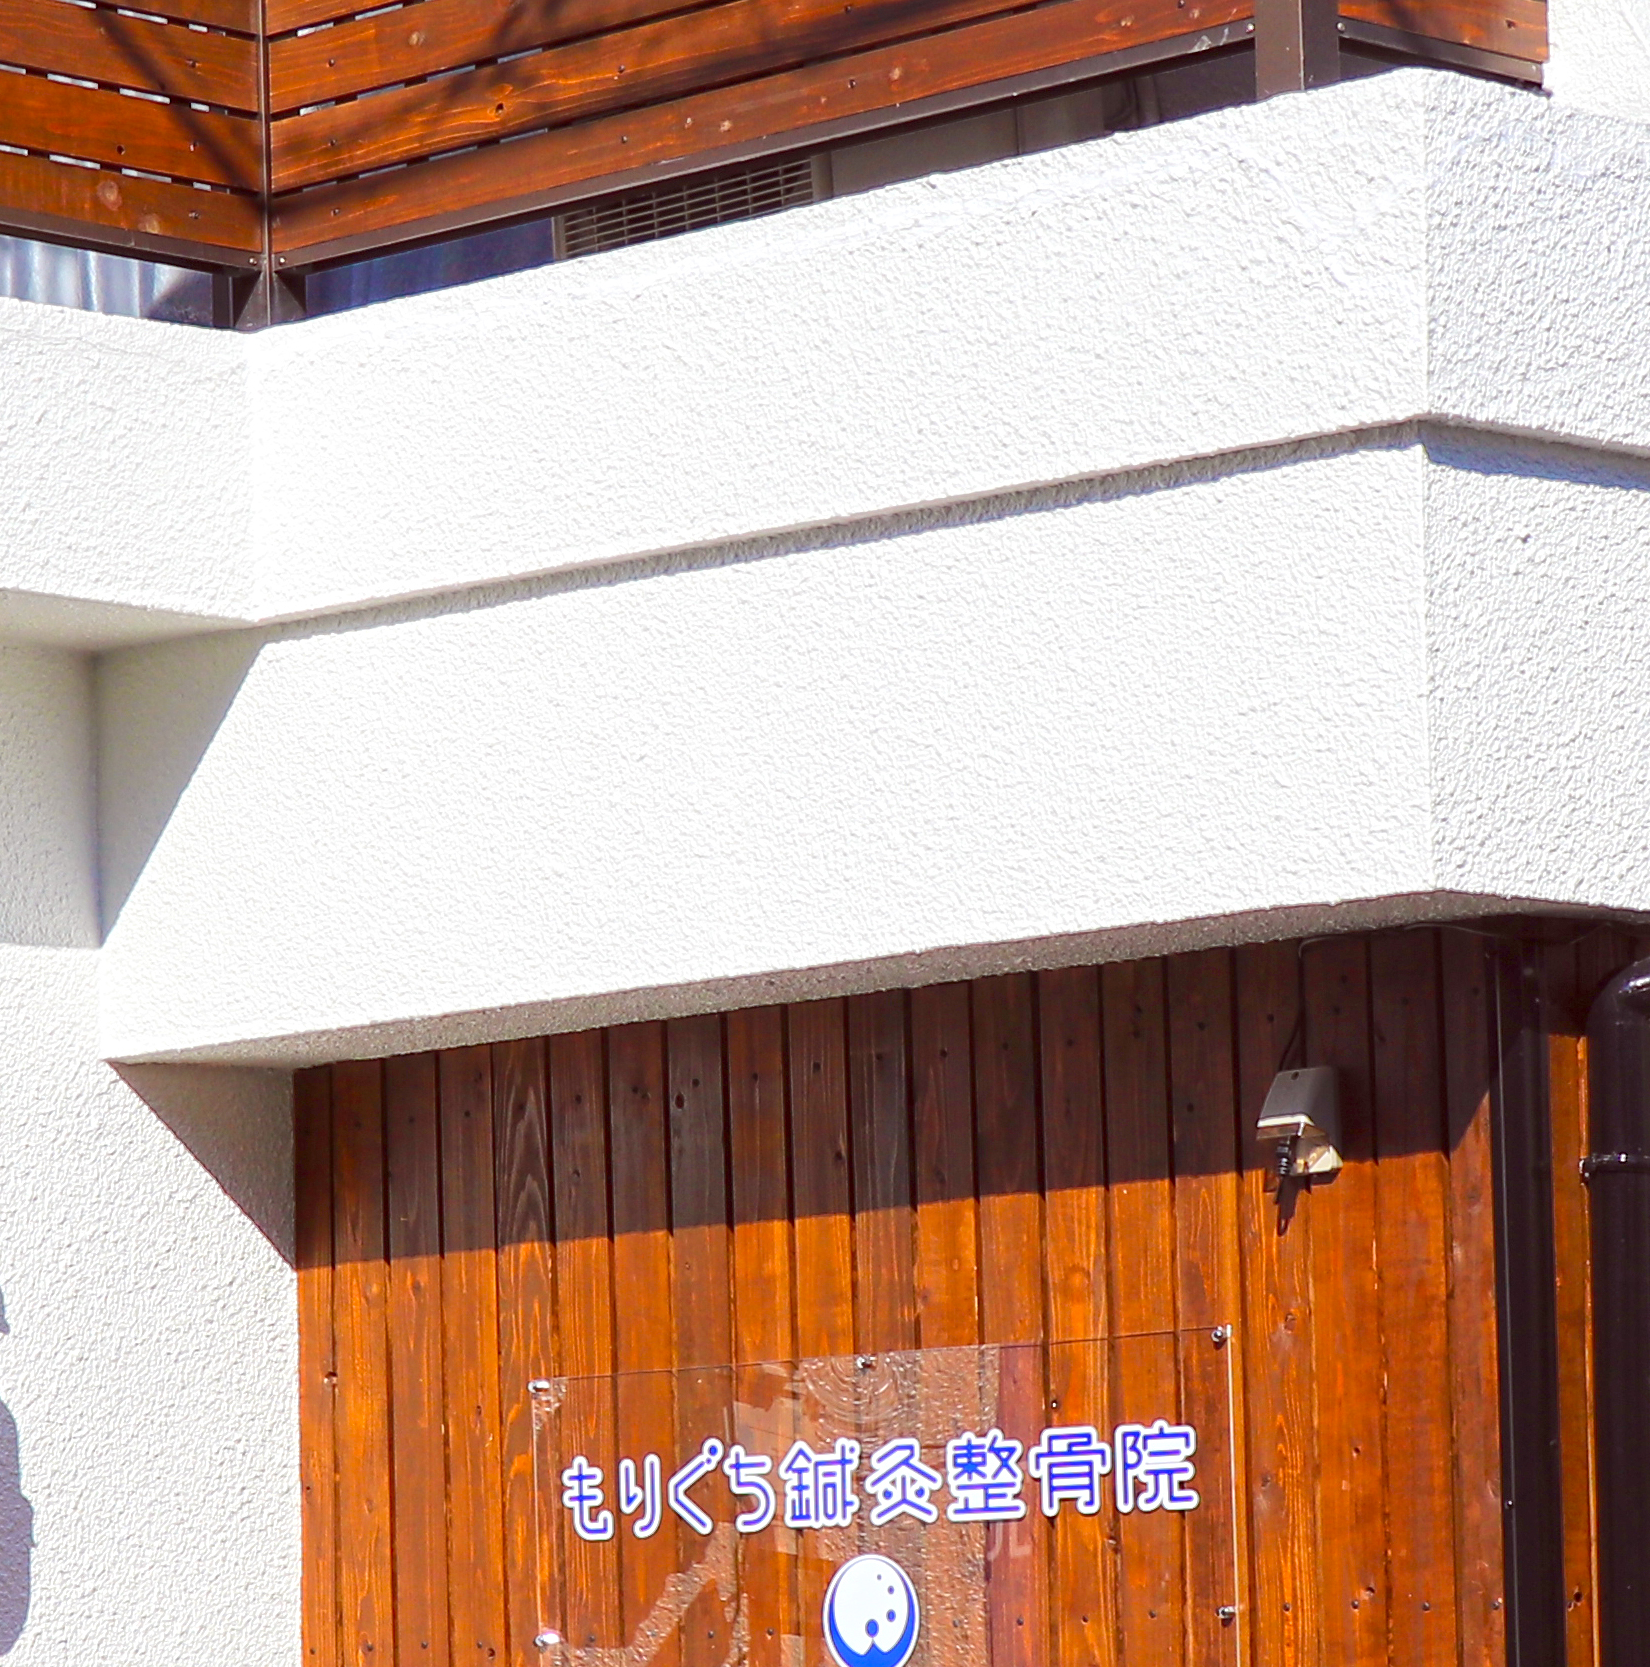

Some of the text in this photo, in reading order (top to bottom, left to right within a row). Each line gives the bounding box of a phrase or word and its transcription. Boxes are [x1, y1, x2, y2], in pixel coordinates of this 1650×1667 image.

[562, 1421, 1199, 1540] もりぐち鍼灸整骨院
